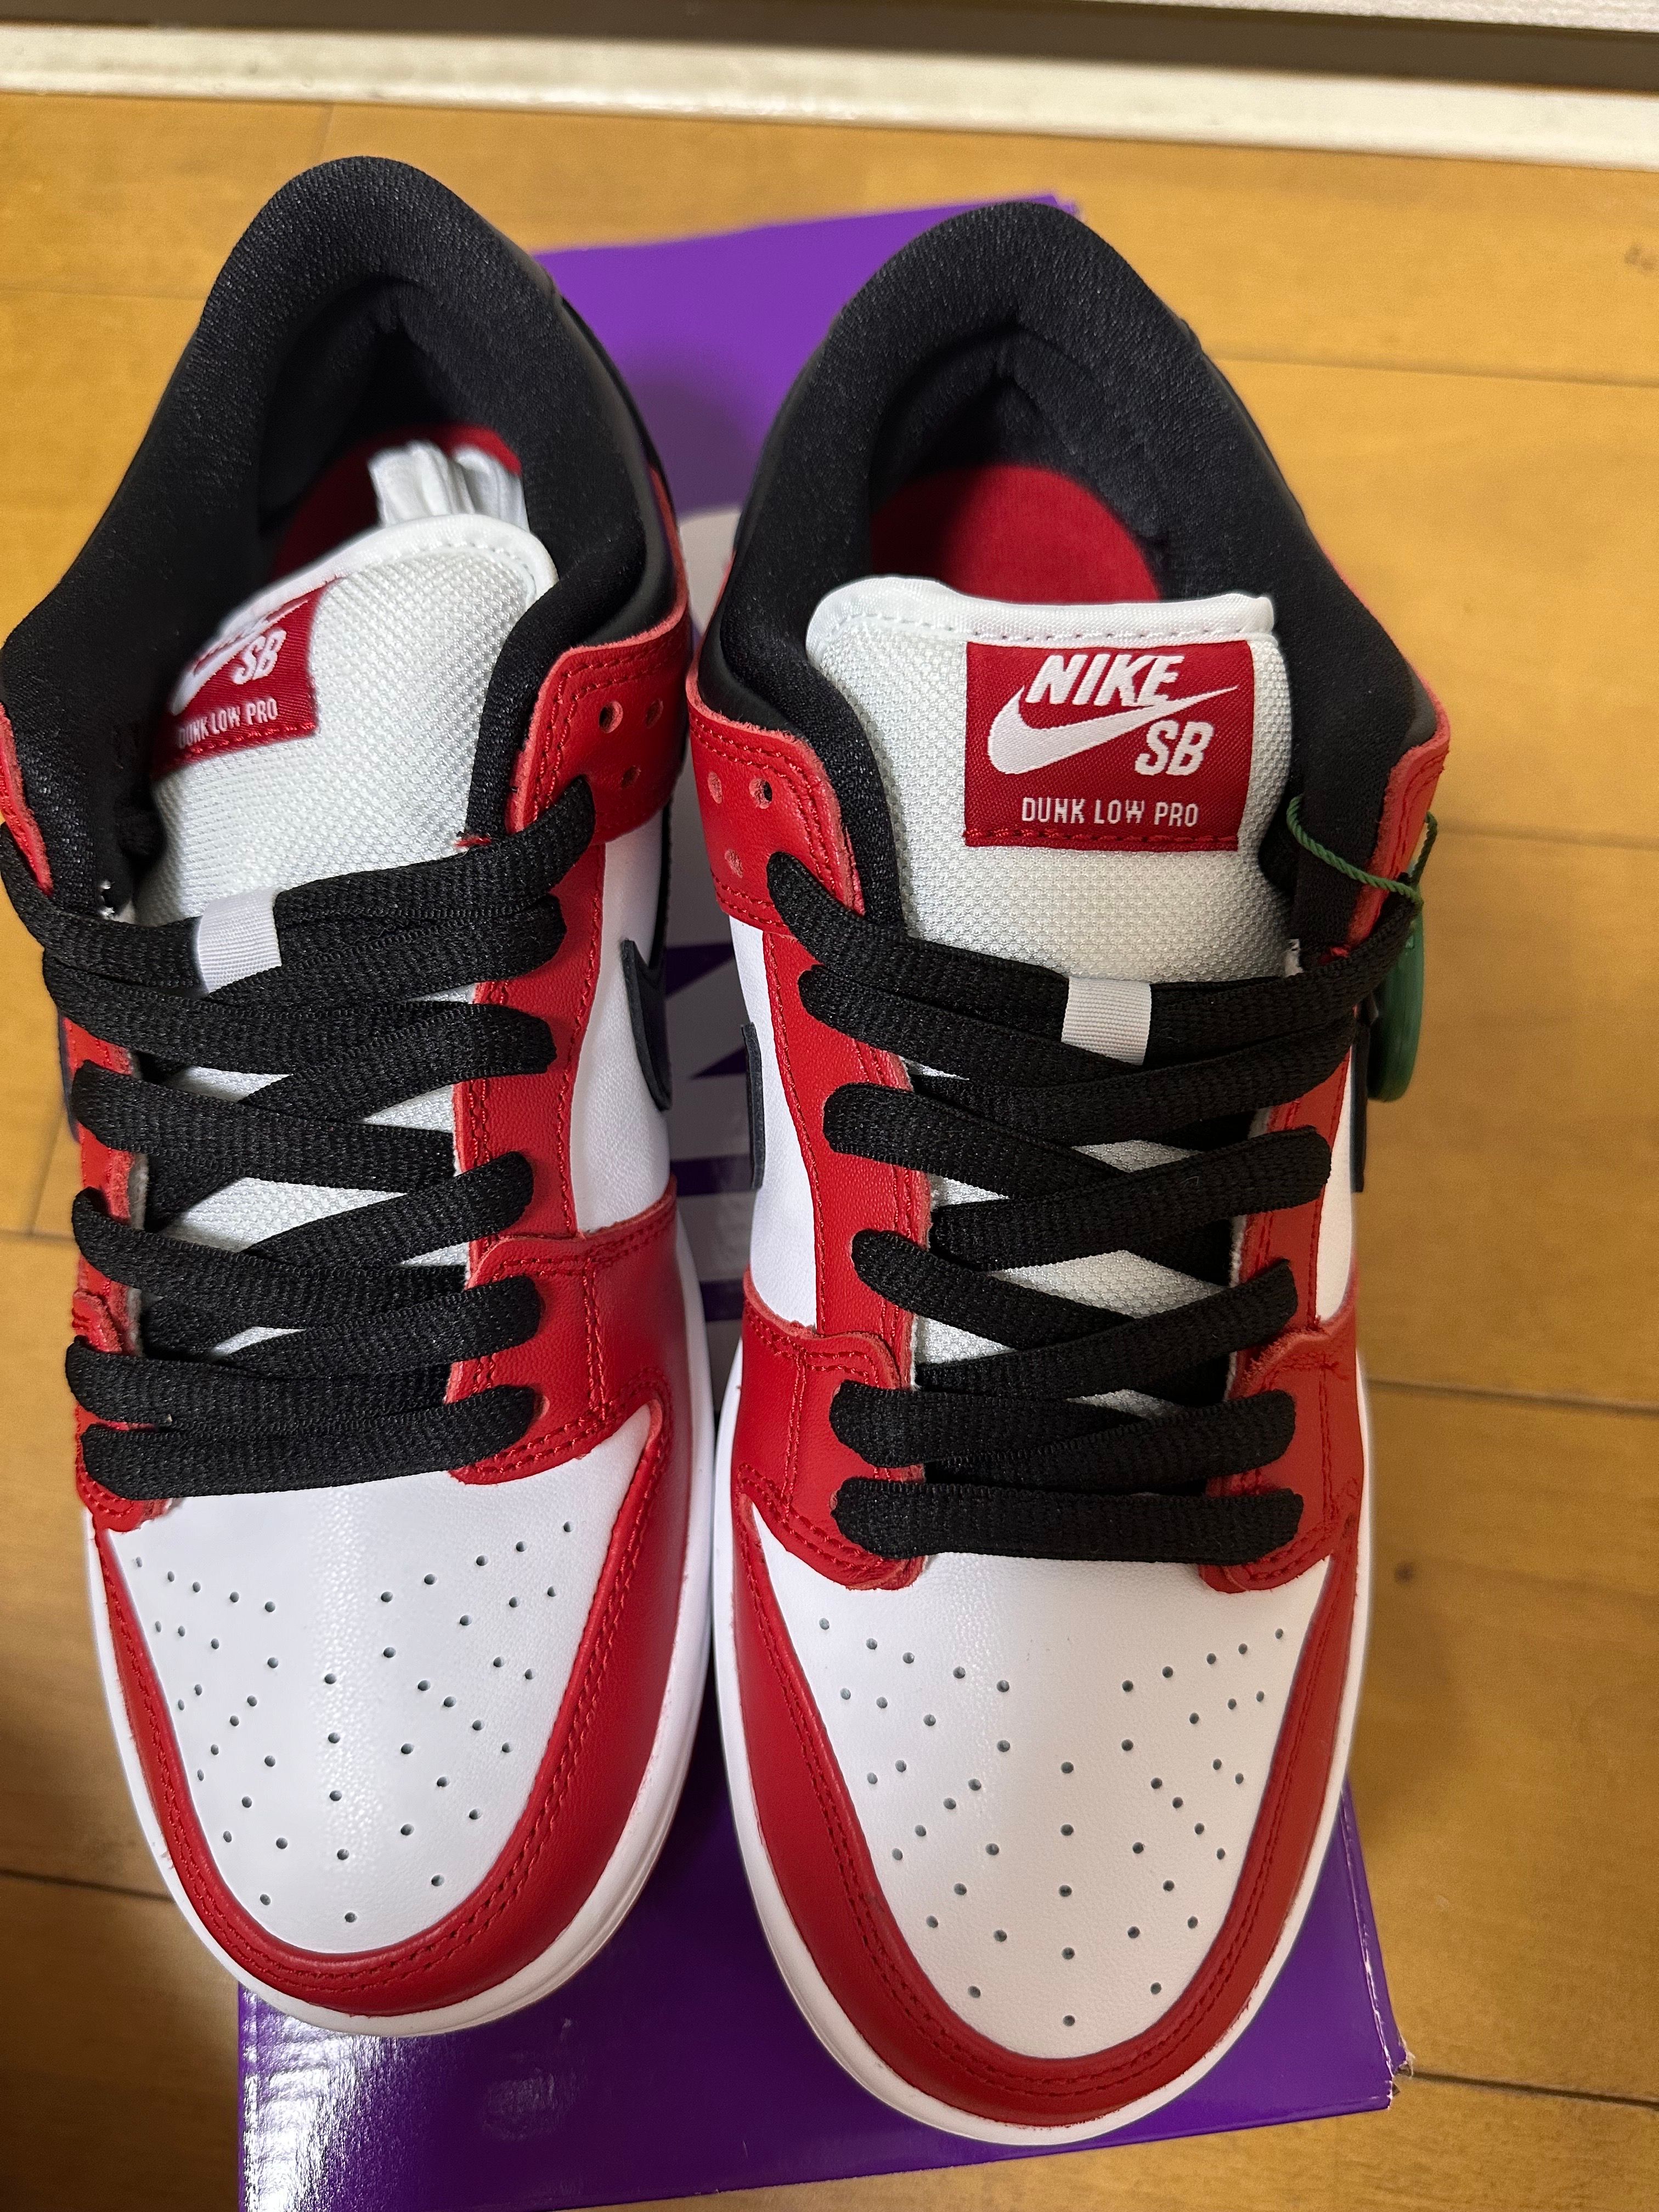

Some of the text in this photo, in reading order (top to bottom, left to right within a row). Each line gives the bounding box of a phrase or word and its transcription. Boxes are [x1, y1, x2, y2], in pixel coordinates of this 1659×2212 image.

[232, 628, 286, 685] SB
[1026, 653, 1185, 707] NIKE
[178, 696, 279, 749] DUNK LOW PRO
[1135, 720, 1214, 776] SB
[1022, 797, 1199, 827] DUNK LOW PRO
